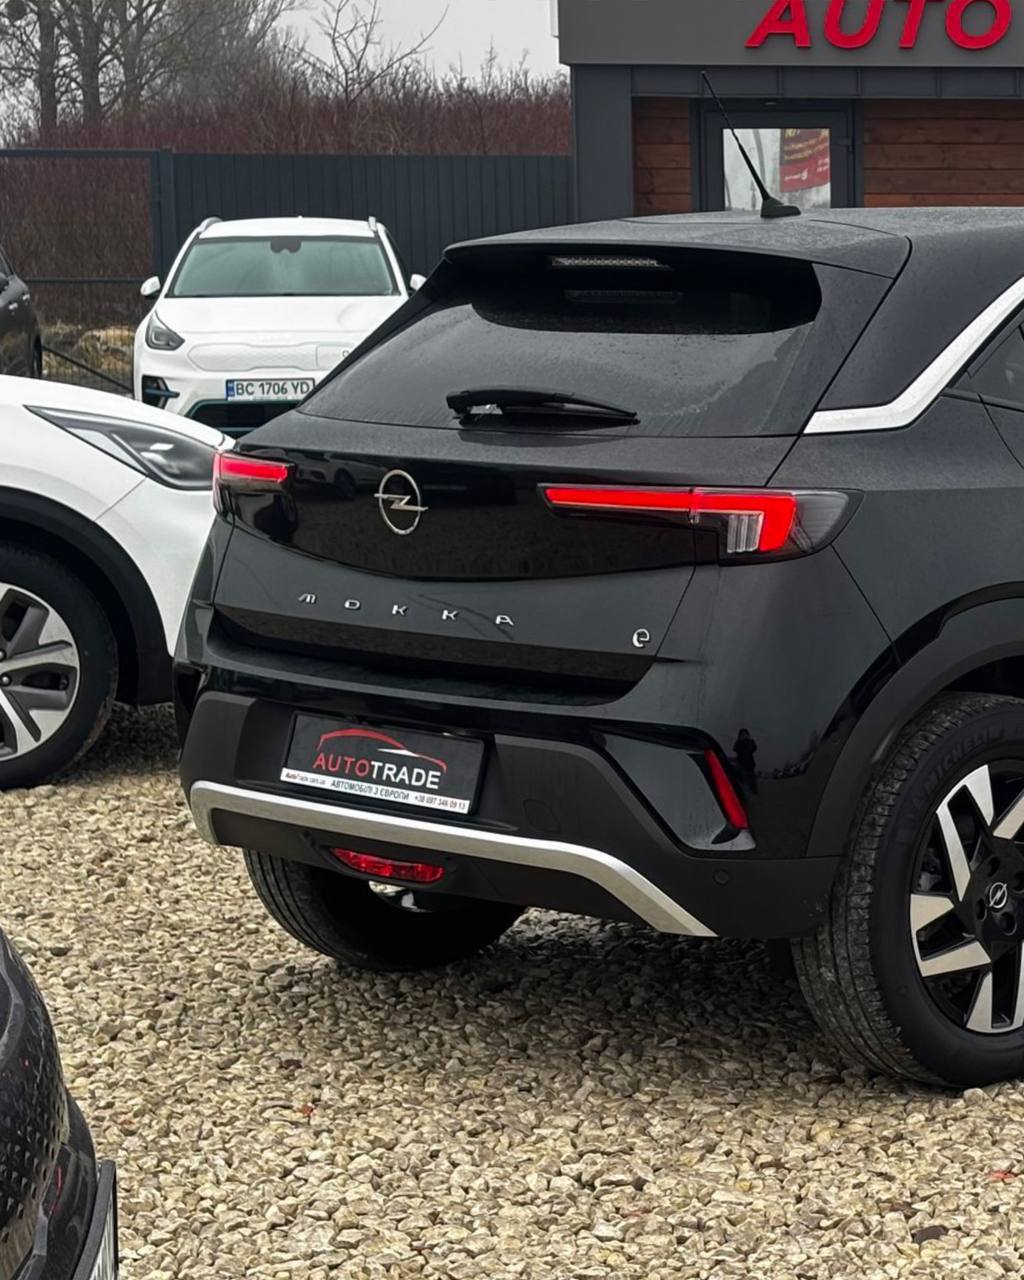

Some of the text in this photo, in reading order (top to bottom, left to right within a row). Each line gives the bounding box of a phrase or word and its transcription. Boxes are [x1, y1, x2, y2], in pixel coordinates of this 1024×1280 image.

[236, 381, 310, 396] BC 1706 YD
